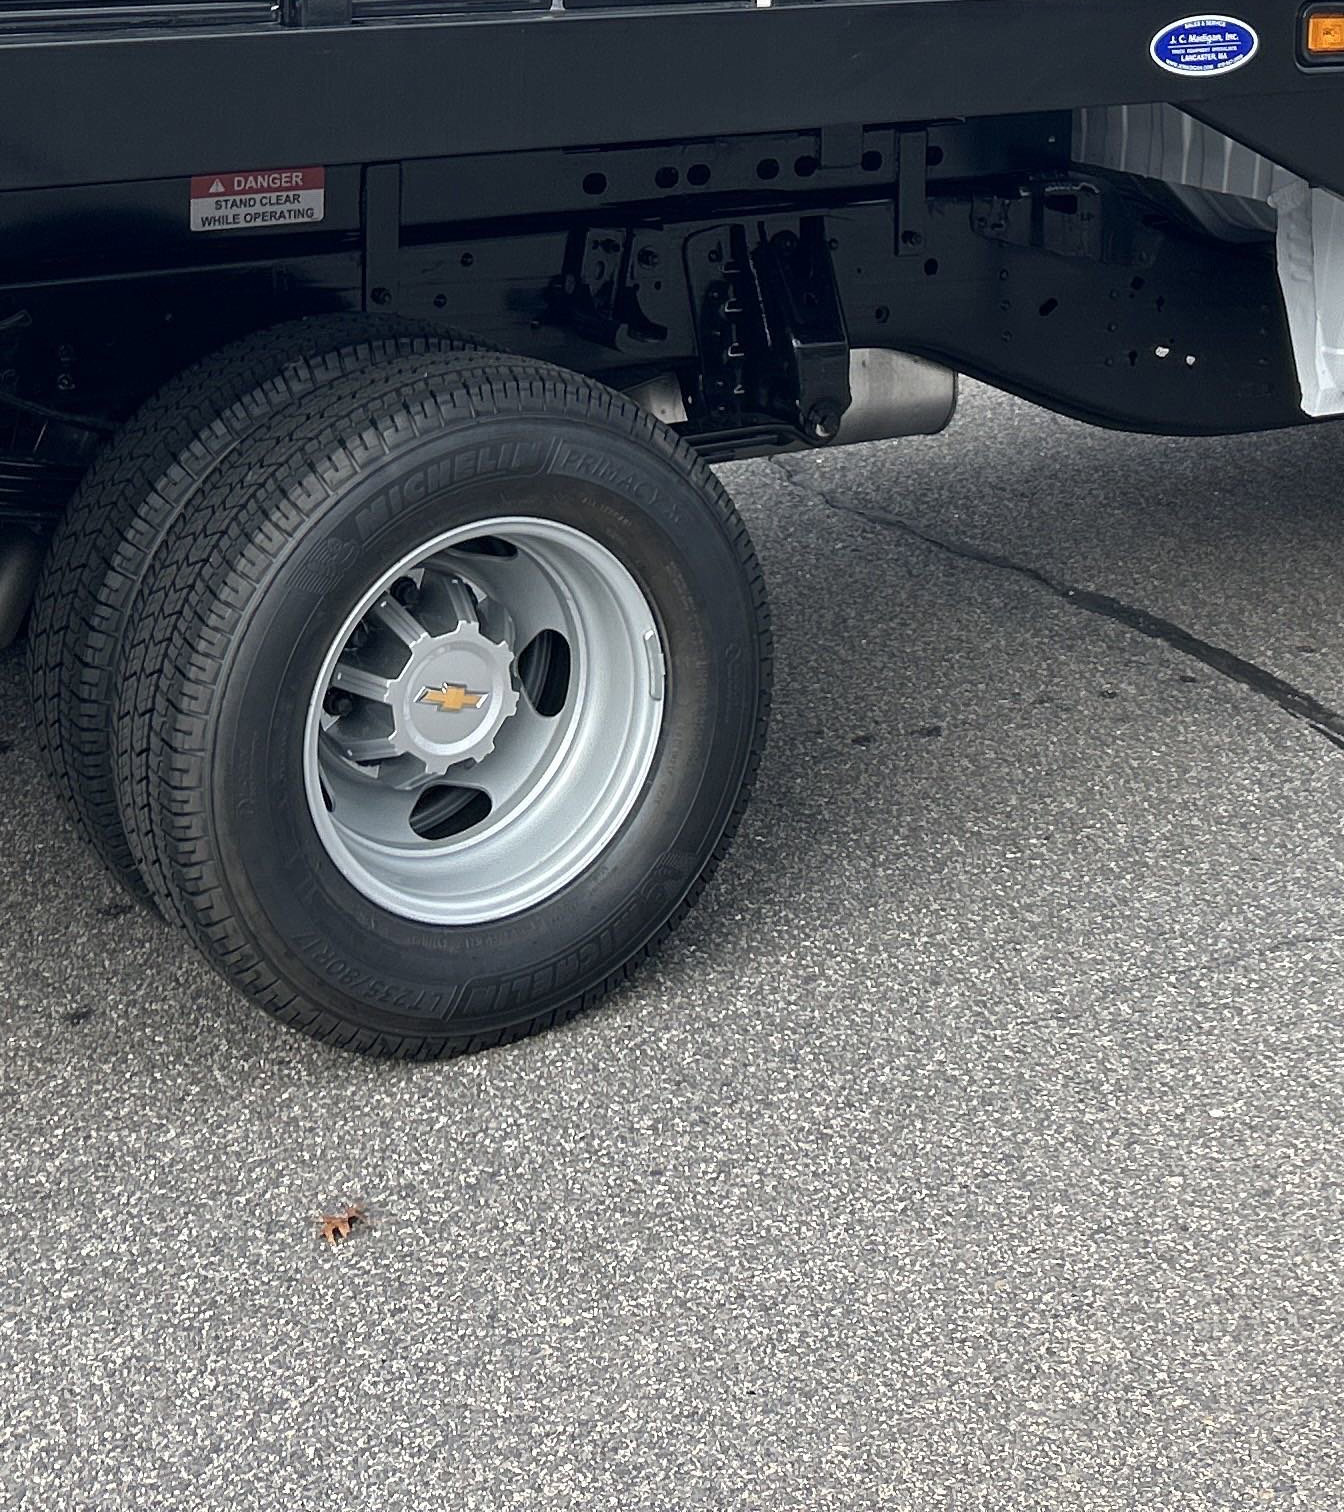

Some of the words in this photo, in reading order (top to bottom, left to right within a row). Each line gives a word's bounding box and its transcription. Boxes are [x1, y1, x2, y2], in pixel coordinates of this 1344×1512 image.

[233, 172, 303, 191] DANGER
[214, 197, 256, 211] STAND
[259, 193, 301, 207] CLEAR
[200, 214, 241, 228] WHILE
[243, 208, 315, 225] OPERATING
[354, 439, 542, 541] MICHELIN
[560, 448, 659, 505] PRIMACY
